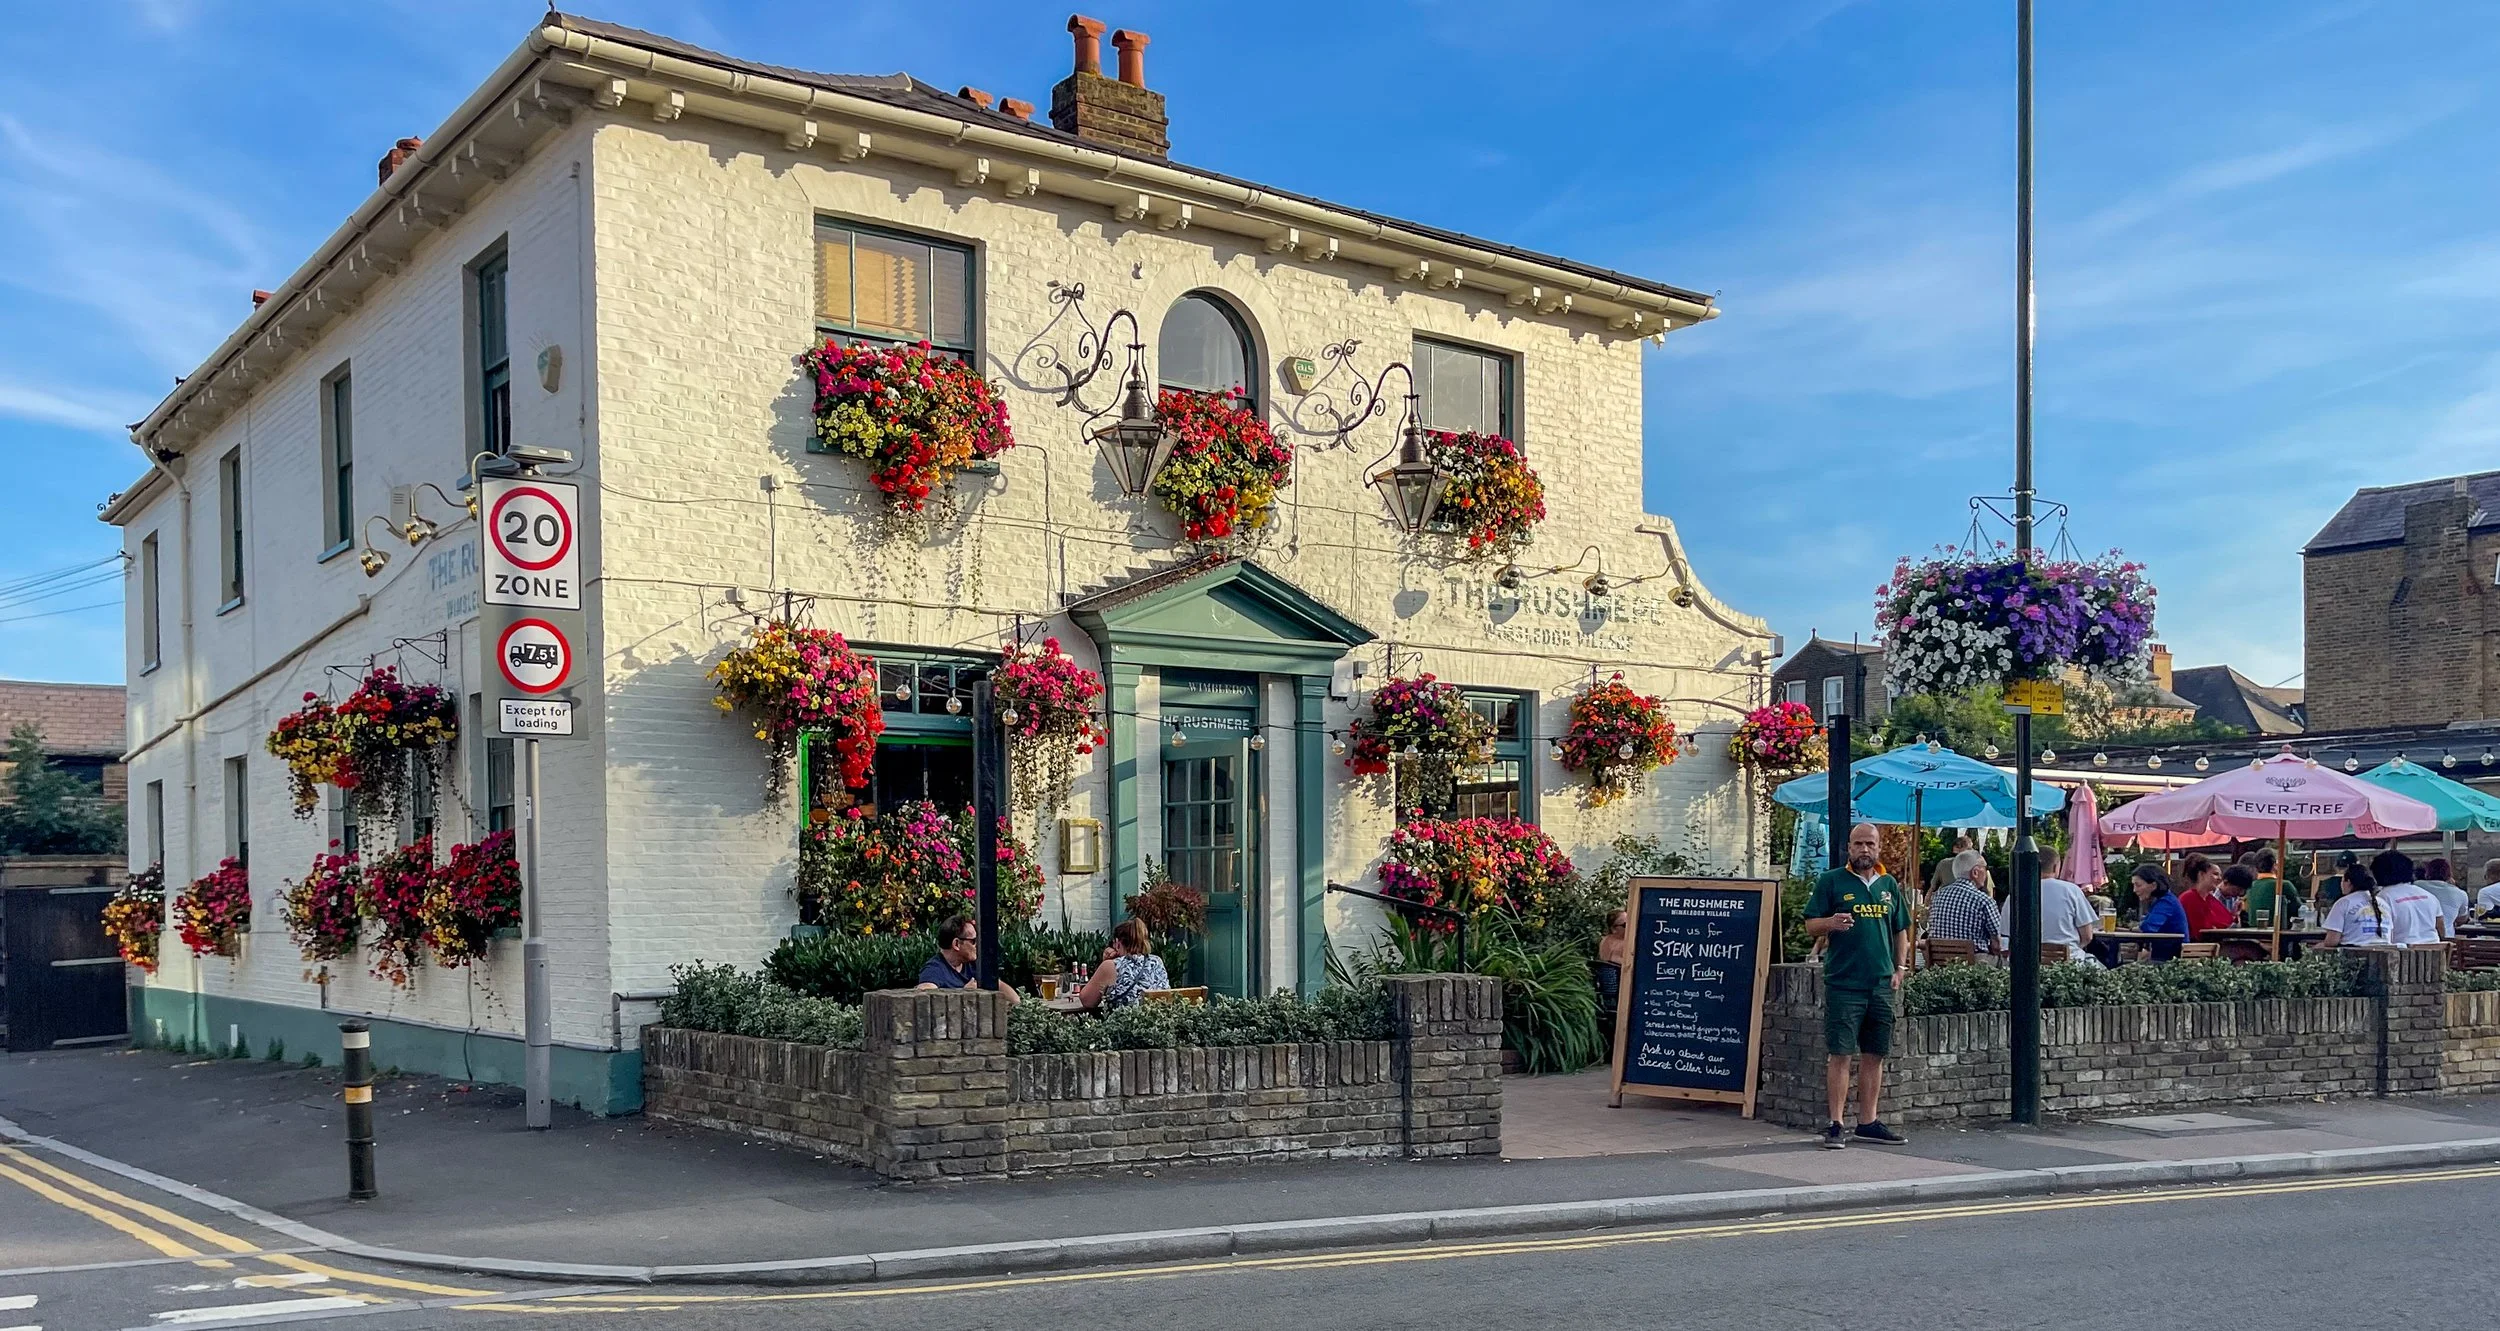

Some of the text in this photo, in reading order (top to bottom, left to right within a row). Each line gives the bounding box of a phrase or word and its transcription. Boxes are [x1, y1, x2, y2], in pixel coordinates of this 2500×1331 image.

[504, 511, 560, 546] 20
[429, 549, 457, 591] THE
[495, 574, 569, 599] ZONE
[1444, 576, 1666, 627] THE RUSHMERE
[526, 645, 556, 661] 7.5t
[1188, 681, 1254, 696] WIMBLEDON
[505, 705, 567, 717] Except for
[515, 718, 558, 730] loading
[1184, 715, 1249, 730] RUSHMERE
[2234, 800, 2344, 815] FEVER-TREE
[1659, 898, 1744, 910] THE RUSHMERE
[1853, 904, 1889, 914] CASTLE
[1707, 922, 1723, 938] for
[1652, 940, 1744, 960] STEAK NIGHT
[1656, 961, 1724, 985] Every Friday
[1642, 1043, 1661, 1055] Ask
[1679, 1049, 1705, 1060] about
[1708, 1055, 1725, 1063] our
[1637, 1053, 1731, 1076] Secret Cellar Wines
